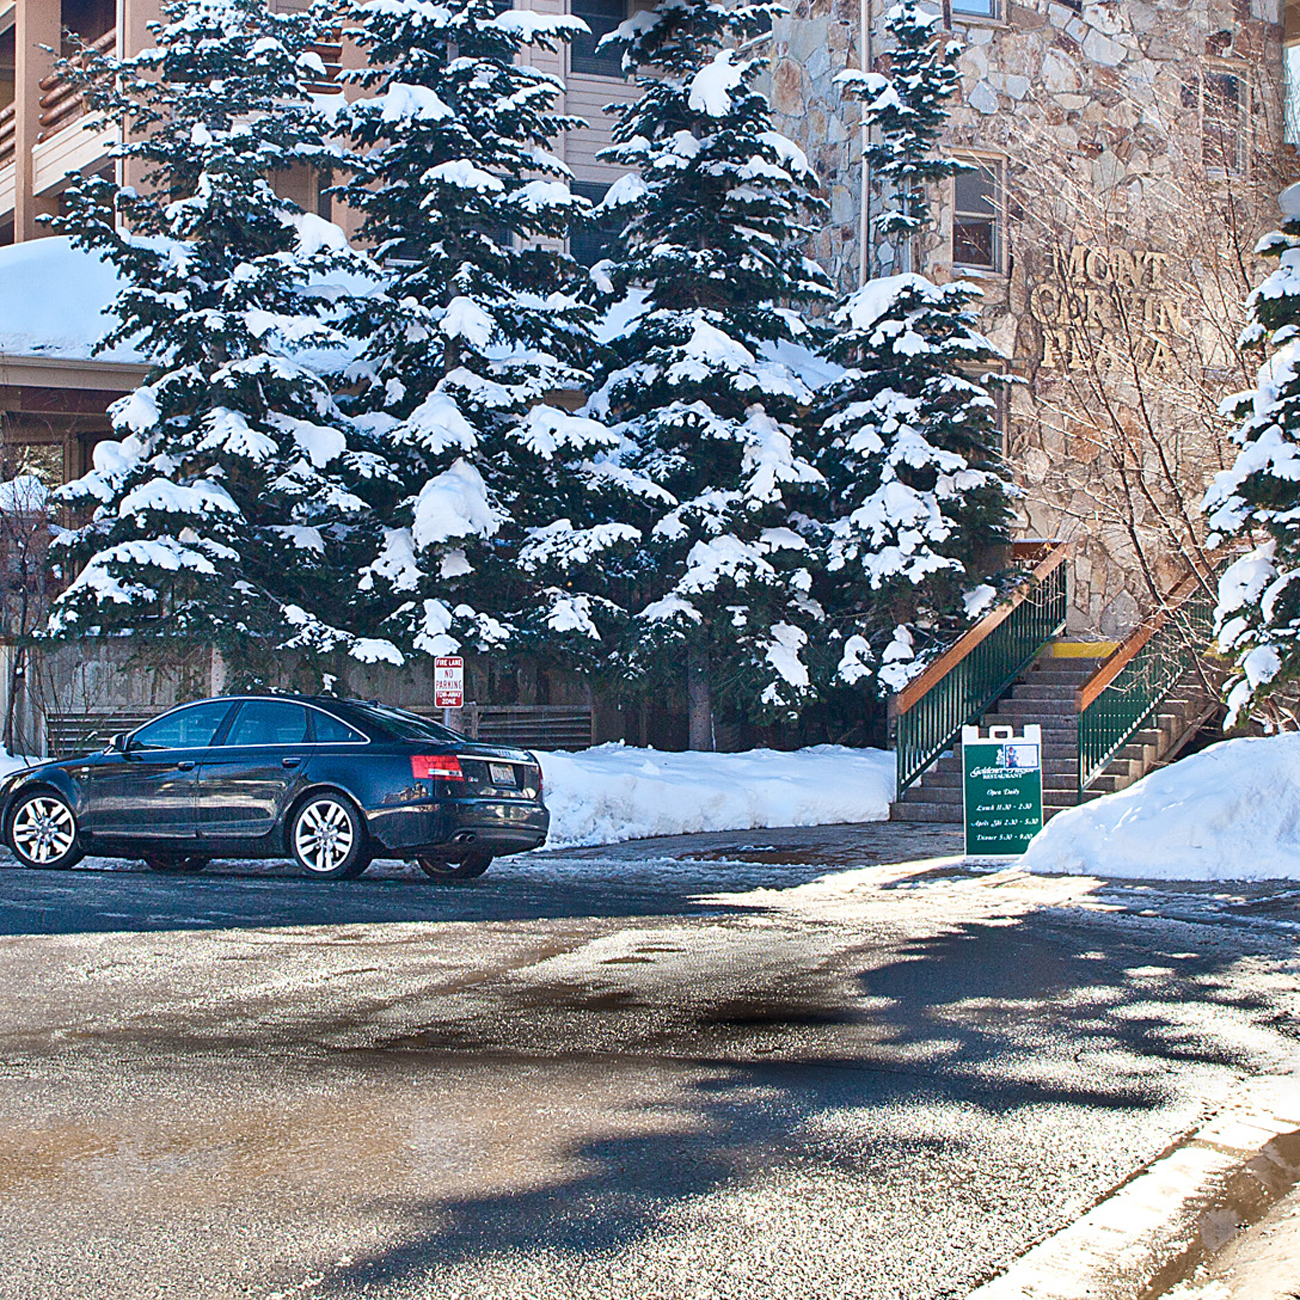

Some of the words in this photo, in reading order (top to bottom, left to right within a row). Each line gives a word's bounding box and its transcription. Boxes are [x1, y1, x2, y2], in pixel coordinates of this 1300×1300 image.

[444, 669, 453, 678] NO
[436, 680, 463, 690] PARKING
[986, 789, 1002, 797] Open
[1003, 788, 1020, 796] Daily
